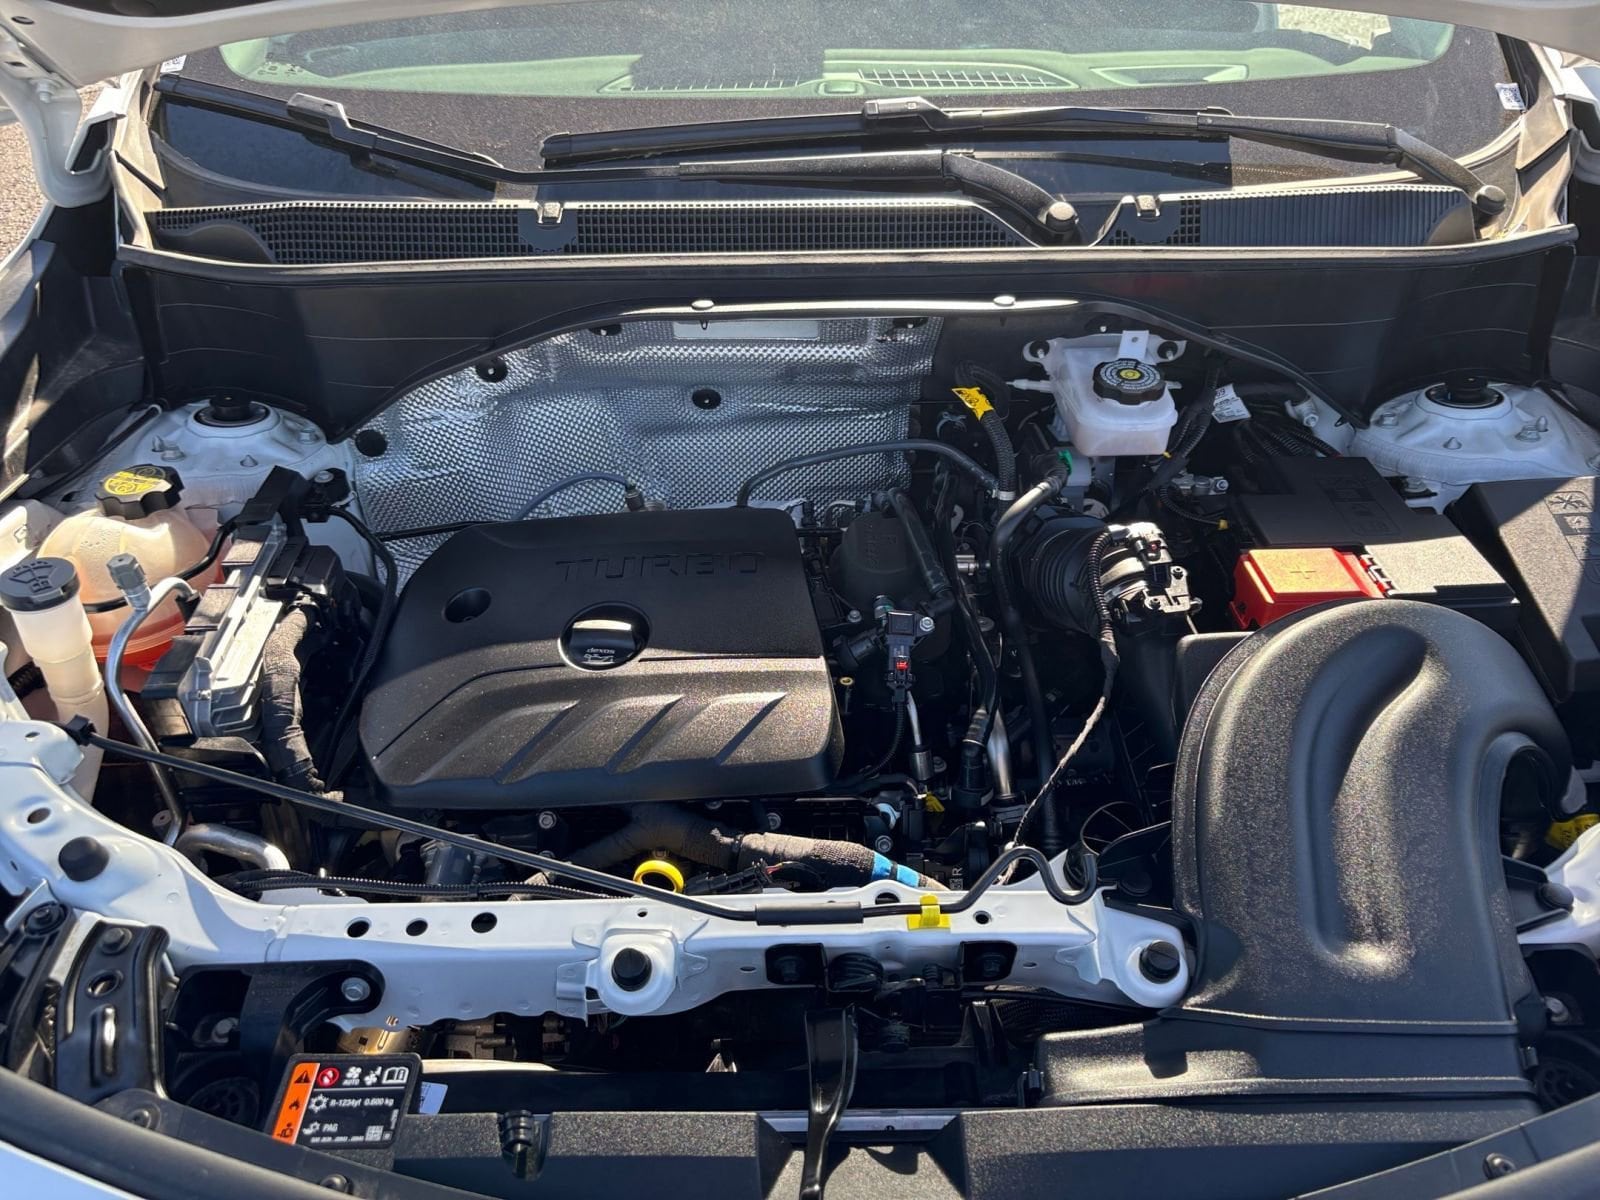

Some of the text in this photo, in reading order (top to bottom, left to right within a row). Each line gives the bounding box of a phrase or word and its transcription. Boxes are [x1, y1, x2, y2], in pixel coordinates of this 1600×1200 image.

[555, 552, 766, 582] TURBO
[385, 1098, 394, 1107] kg
[322, 1123, 338, 1132] PAG
